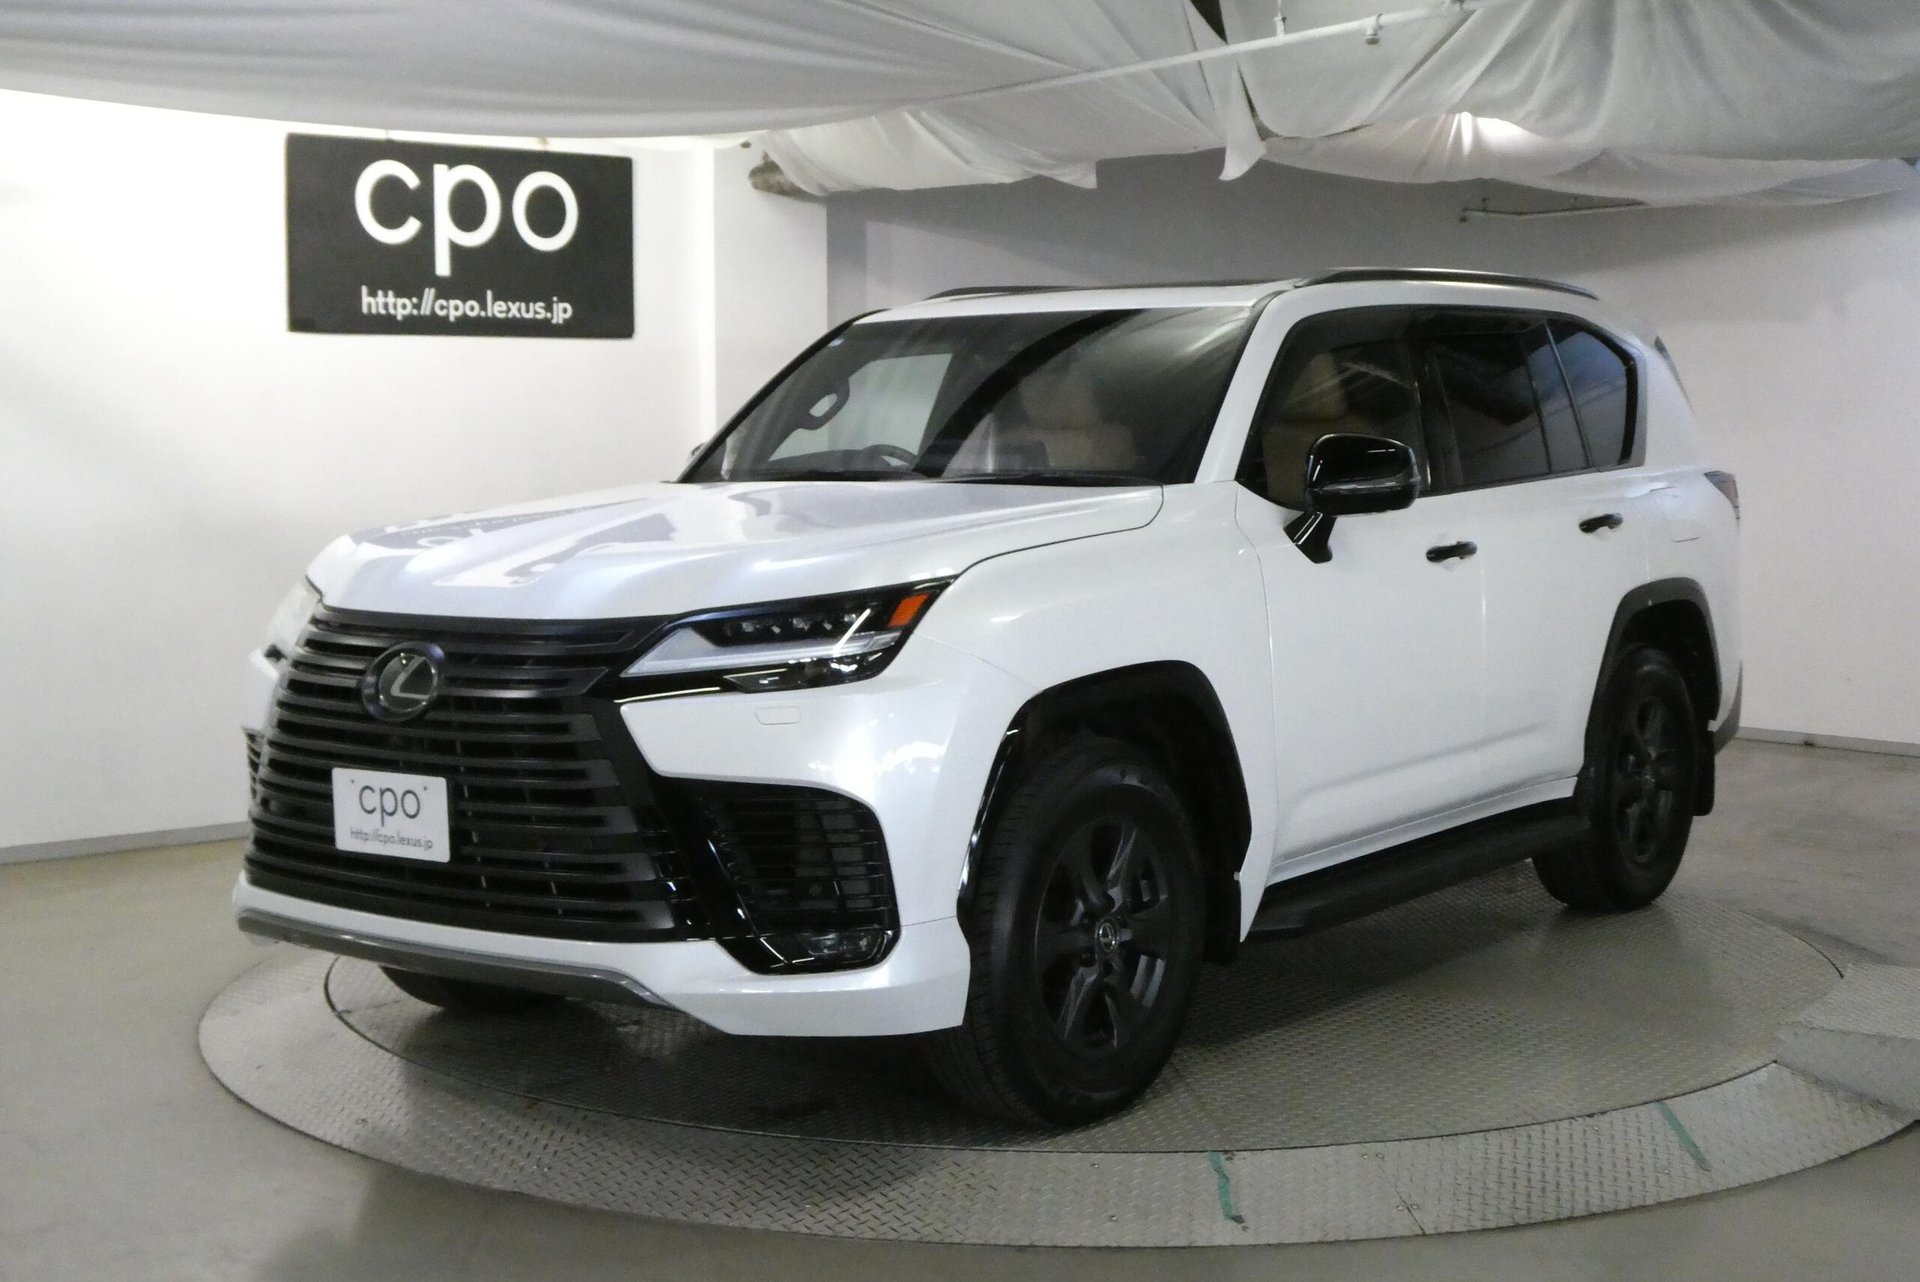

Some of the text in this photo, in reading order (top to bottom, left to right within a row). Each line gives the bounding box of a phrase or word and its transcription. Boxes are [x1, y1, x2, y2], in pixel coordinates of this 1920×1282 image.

[354, 158, 579, 277] cpo
[360, 284, 573, 325] http://cpo.lexus.jp
[359, 785, 421, 827] cpo
[350, 826, 433, 852] http://cpo.lexus.jp
